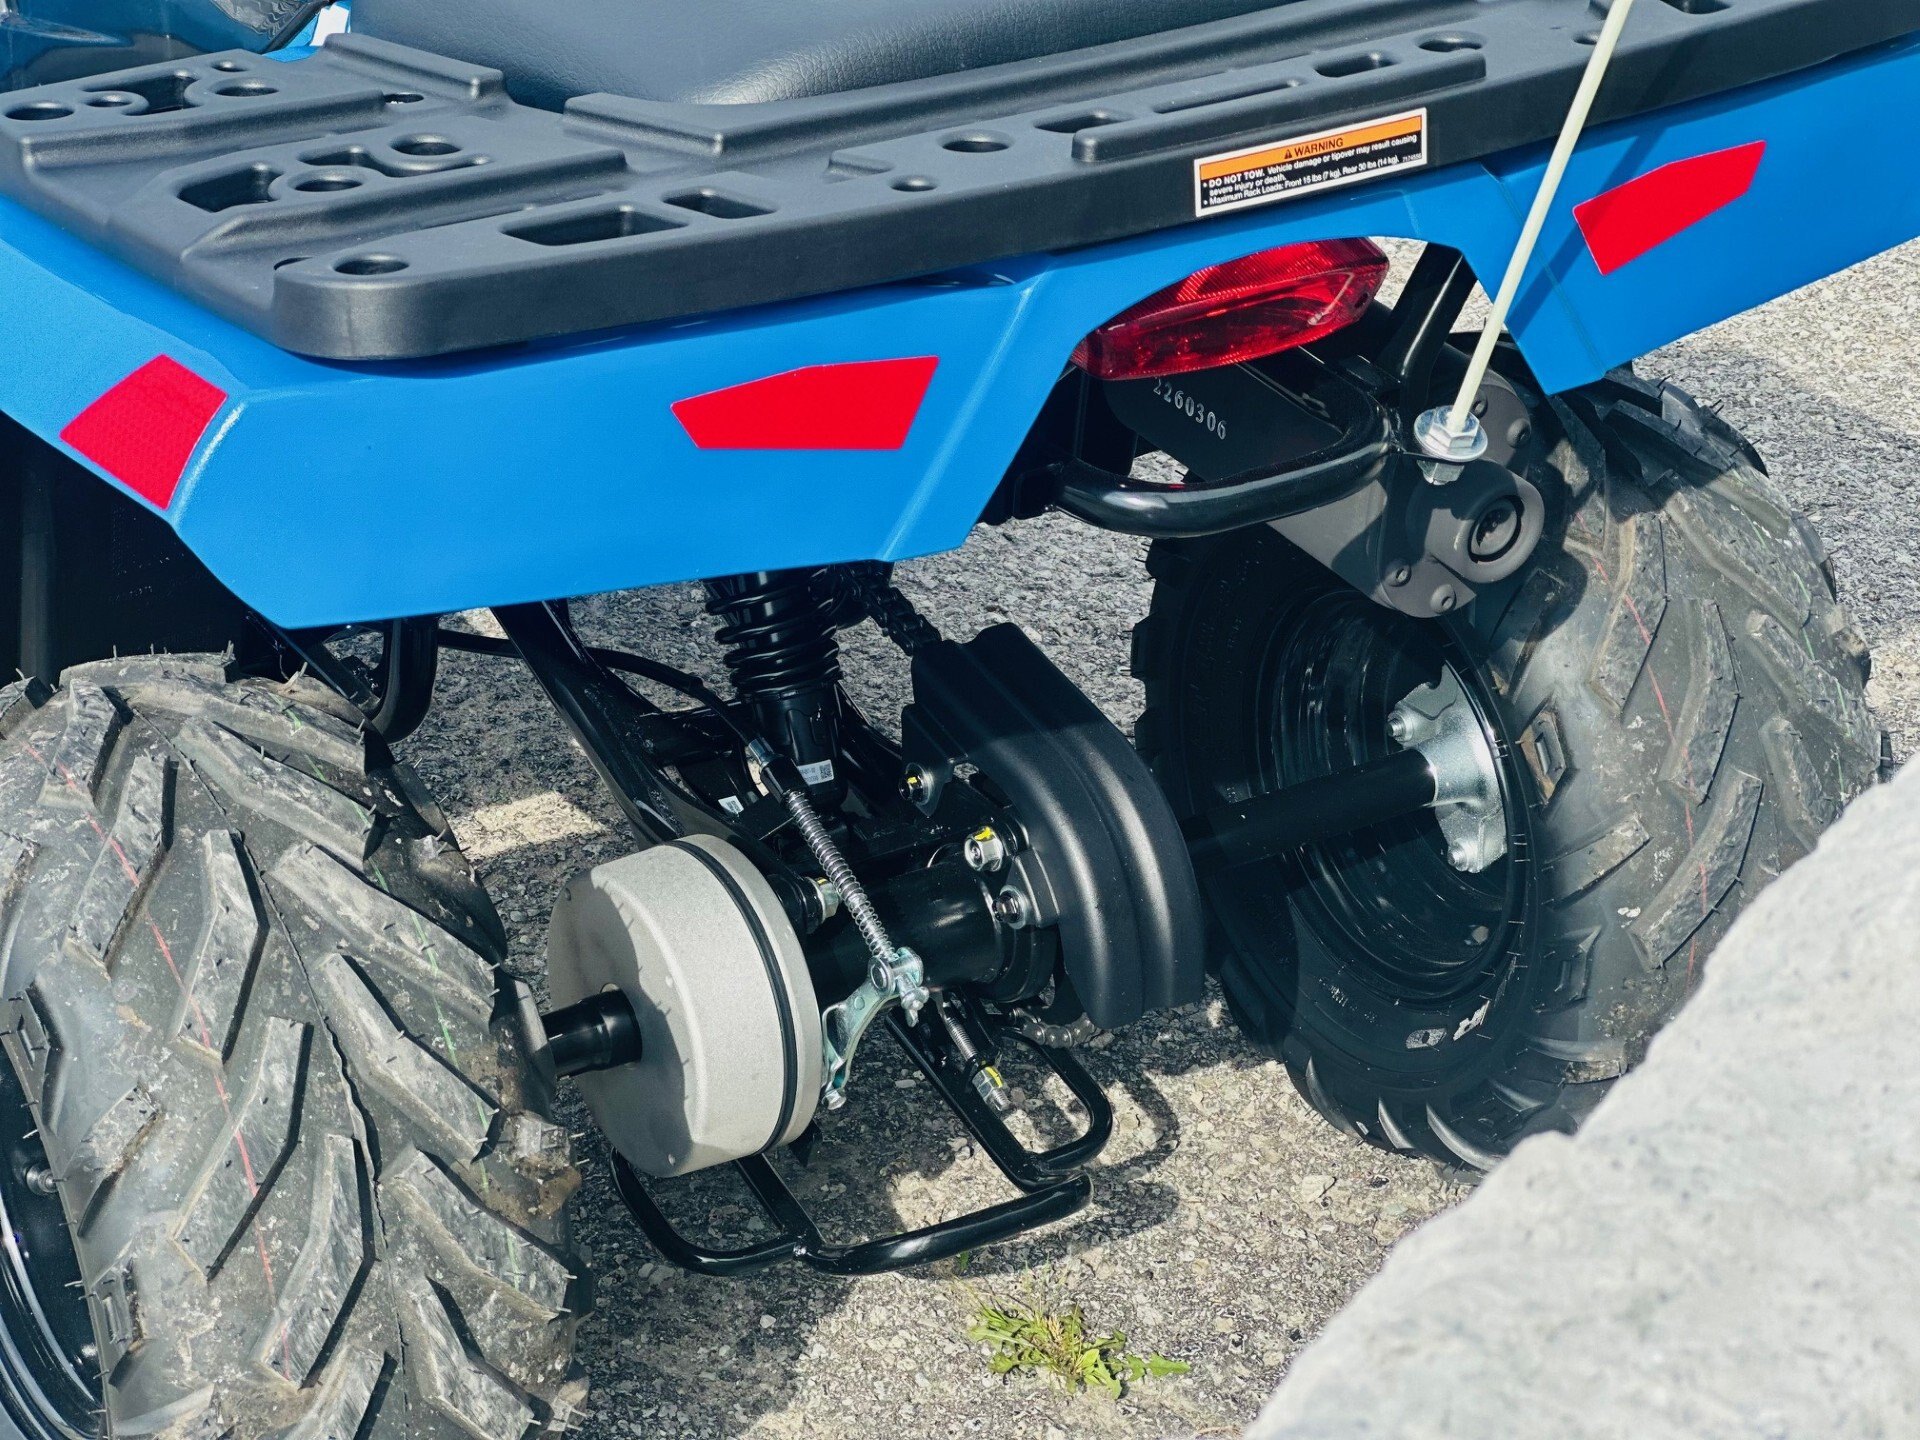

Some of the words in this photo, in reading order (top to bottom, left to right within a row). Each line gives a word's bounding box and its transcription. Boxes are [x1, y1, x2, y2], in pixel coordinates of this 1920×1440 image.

[1209, 179, 1222, 188] DO
[1224, 174, 1242, 184] NOT
[1244, 169, 1265, 180] TOW.
[1267, 164, 1293, 174] Vehicle
[1294, 158, 1321, 168] damage
[1331, 149, 1355, 160] tipover
[1356, 144, 1370, 154] may
[1371, 140, 1390, 150] result
[1391, 134, 1417, 145] causing
[1294, 138, 1343, 156] WARNING
[1209, 193, 1243, 205] Maximum
[1244, 188, 1261, 198] Rack
[1262, 183, 1283, 194] Loads:
[1284, 178, 1302, 188] Front
[1303, 175, 1311, 184] 15
[1312, 172, 1322, 182] lbs
[1342, 165, 1357, 175] Rear
[1358, 162, 1367, 171] 30
[1367, 160, 1377, 169] lbs
[1377, 157, 1387, 168] (14
[1209, 186, 1233, 197] severe
[1235, 181, 1253, 192] injury
